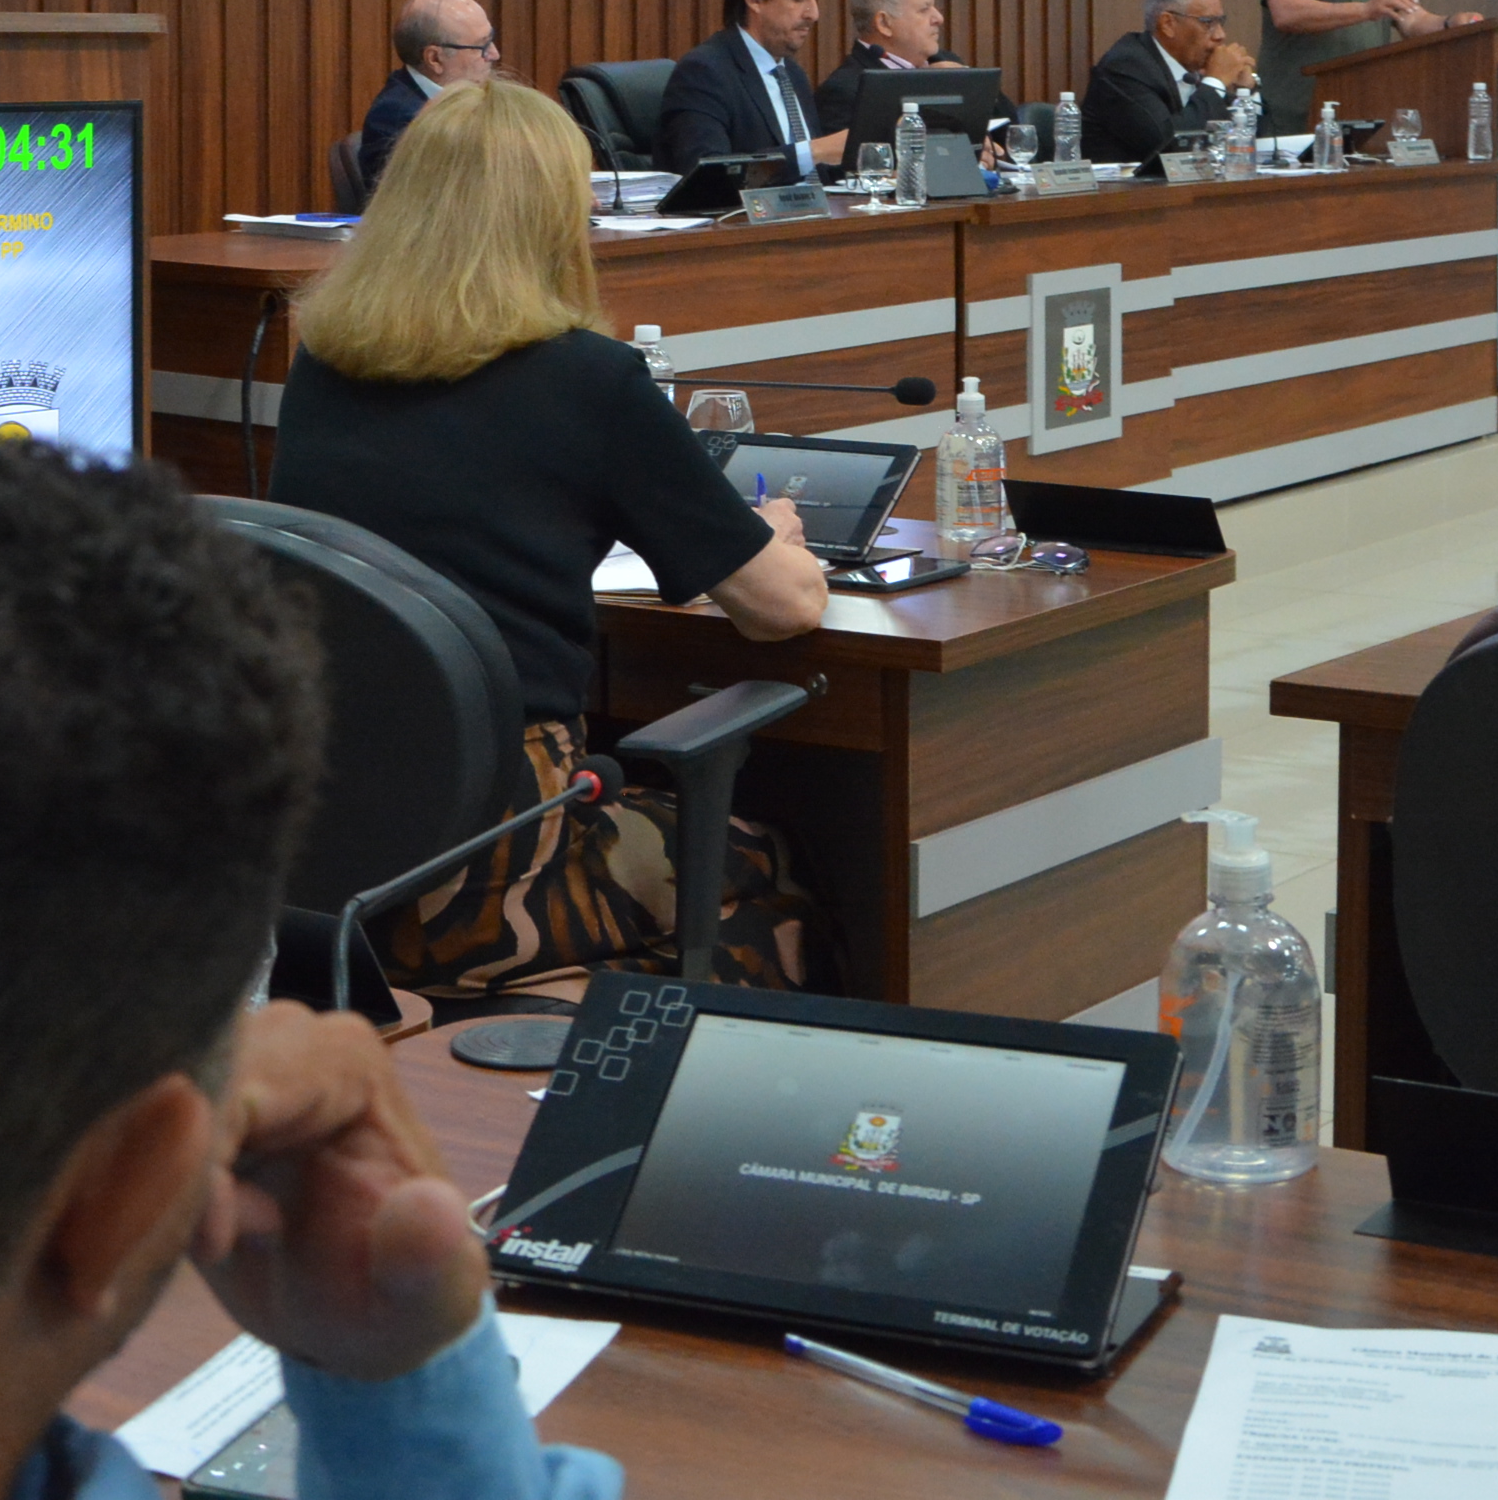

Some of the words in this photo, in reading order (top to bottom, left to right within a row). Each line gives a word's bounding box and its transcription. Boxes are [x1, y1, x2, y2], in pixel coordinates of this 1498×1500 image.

[1, 241, 24, 259] PP
[739, 1162, 795, 1181] CÂMARA
[798, 1170, 872, 1192] MUNICIPAL
[877, 1181, 899, 1195] DE
[960, 1192, 981, 1205] SP
[499, 1229, 594, 1266] install
[934, 1310, 999, 1332] TERMINAL
[1001, 1321, 1022, 1335] DE
[1023, 1324, 1090, 1345] VOTAÇÃO
